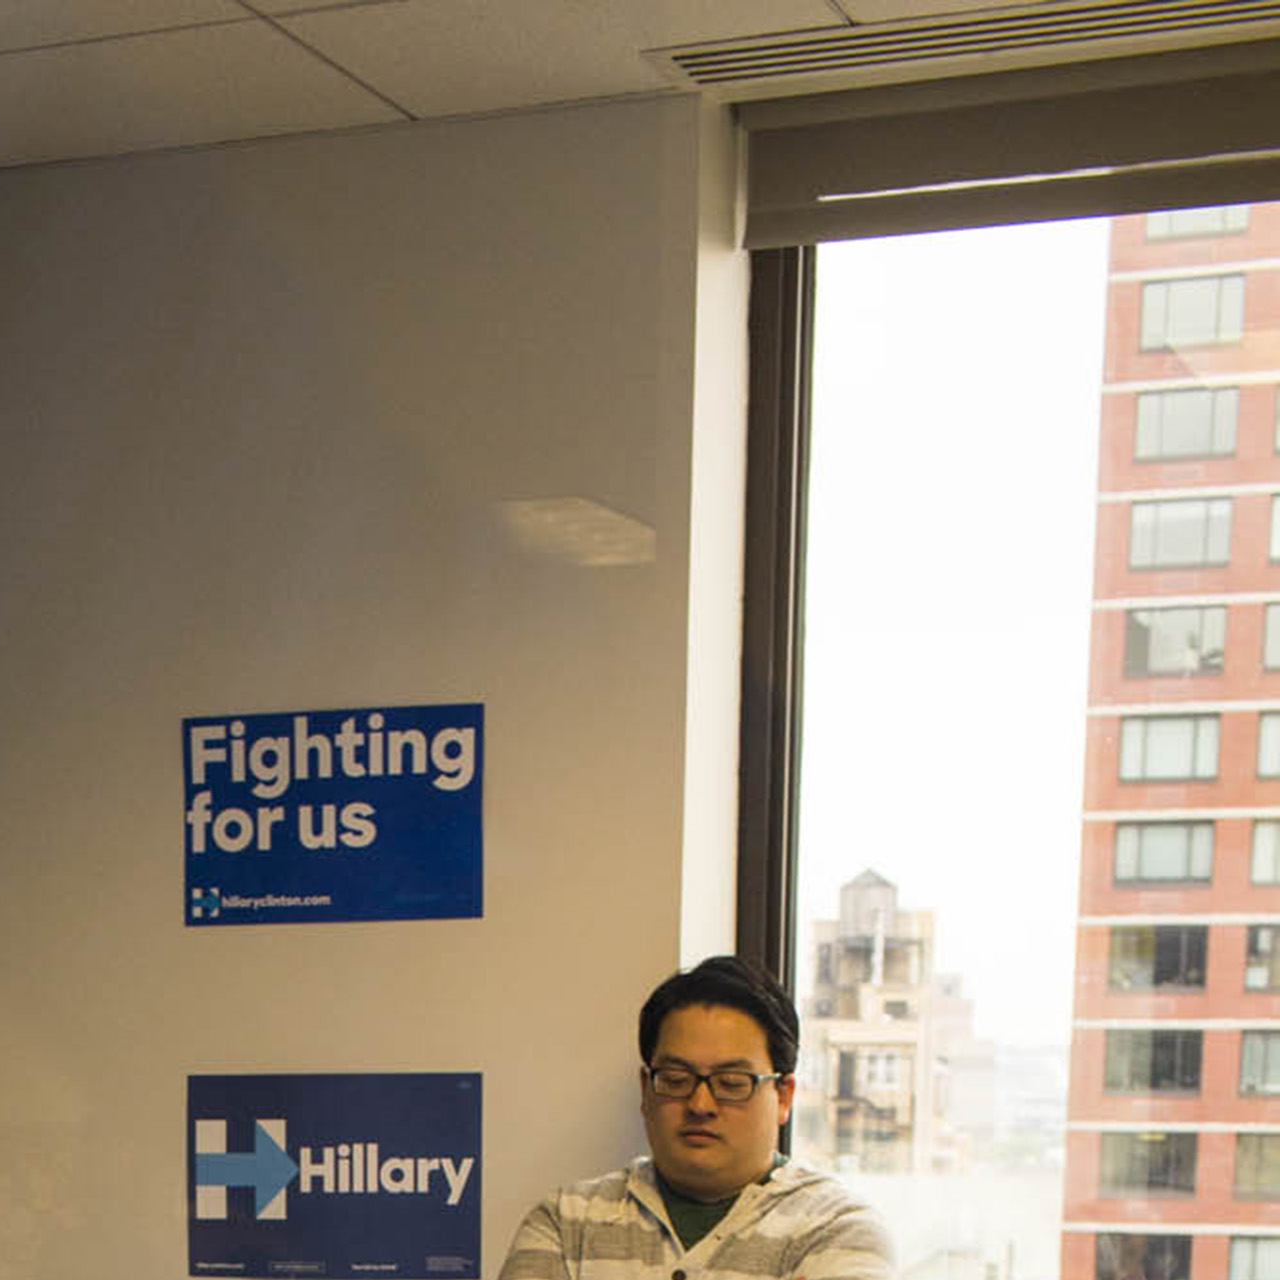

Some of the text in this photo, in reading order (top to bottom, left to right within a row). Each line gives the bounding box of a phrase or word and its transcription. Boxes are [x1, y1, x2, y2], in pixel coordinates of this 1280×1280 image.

[190, 712, 476, 799] Fighting
[186, 790, 378, 854] for us
[221, 894, 332, 911] hillaryclinton.com
[299, 1142, 475, 1205] Hillary
